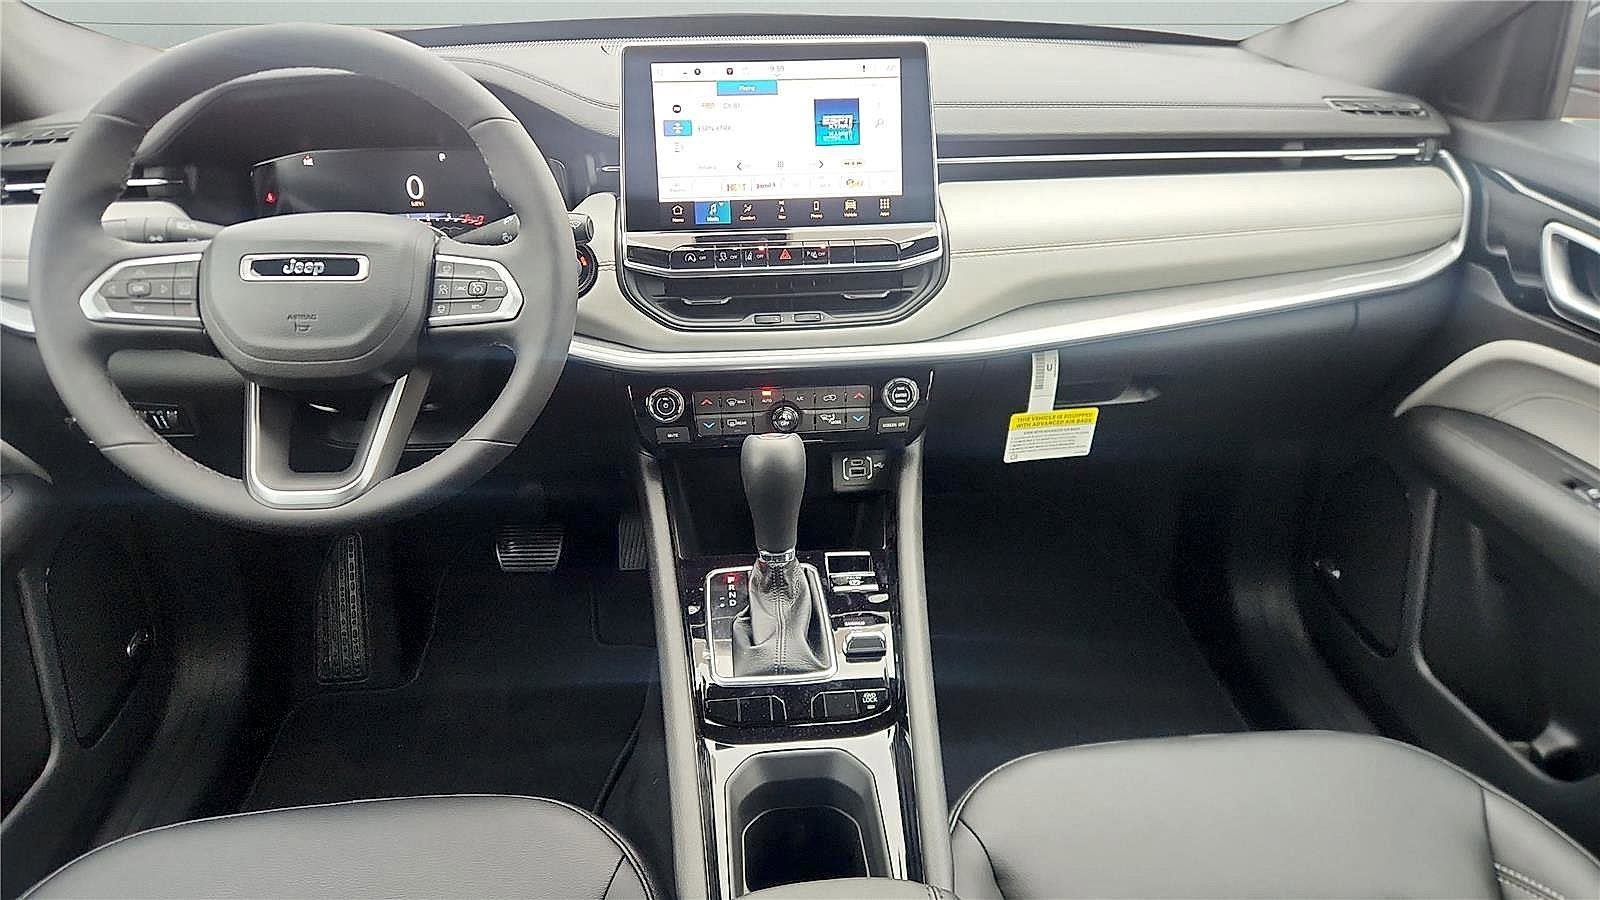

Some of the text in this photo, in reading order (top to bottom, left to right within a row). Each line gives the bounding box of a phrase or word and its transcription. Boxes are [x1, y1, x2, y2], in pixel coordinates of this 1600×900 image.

[406, 175, 424, 200] 0
[282, 258, 325, 276] Jeep
[1032, 418, 1064, 428] ADVANCED
[727, 576, 735, 584] P
[728, 591, 737, 599] N
[729, 599, 737, 607] D
